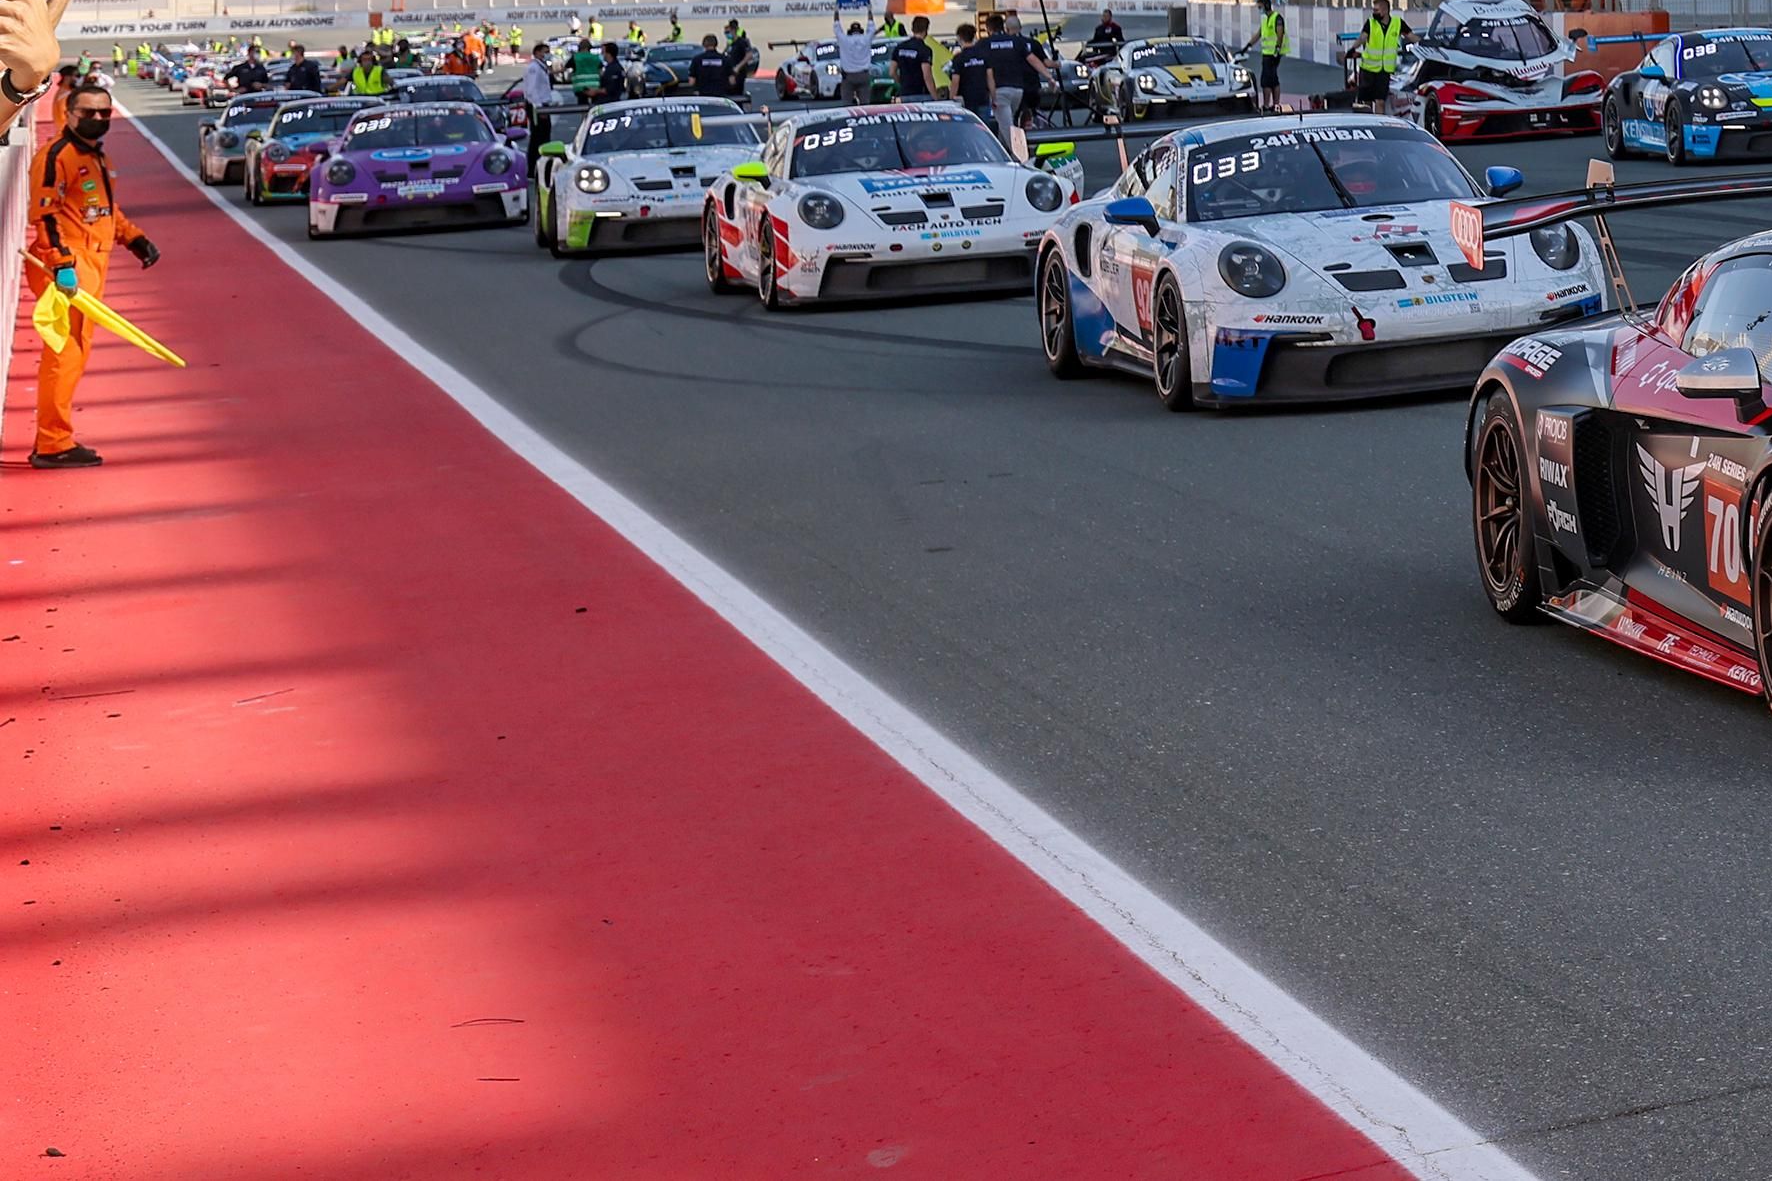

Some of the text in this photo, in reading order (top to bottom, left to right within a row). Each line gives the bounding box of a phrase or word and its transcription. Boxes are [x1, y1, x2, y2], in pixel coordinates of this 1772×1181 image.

[80, 24, 111, 34] NOW
[140, 22, 172, 32] YOUR
[176, 21, 207, 31] TURN
[230, 19, 265, 29] DUBAI
[268, 16, 334, 27] AUTODROME
[1683, 43, 1717, 60] 038
[353, 117, 392, 135] 039
[589, 116, 632, 136] 037
[1250, 129, 1377, 151] 24H DUBAI
[1192, 151, 1261, 185] 033
[892, 218, 1001, 232] FACH AUTO TECH
[1424, 291, 1478, 306] BILSTEIN
[1707, 452, 1747, 483] 24H SERIES
